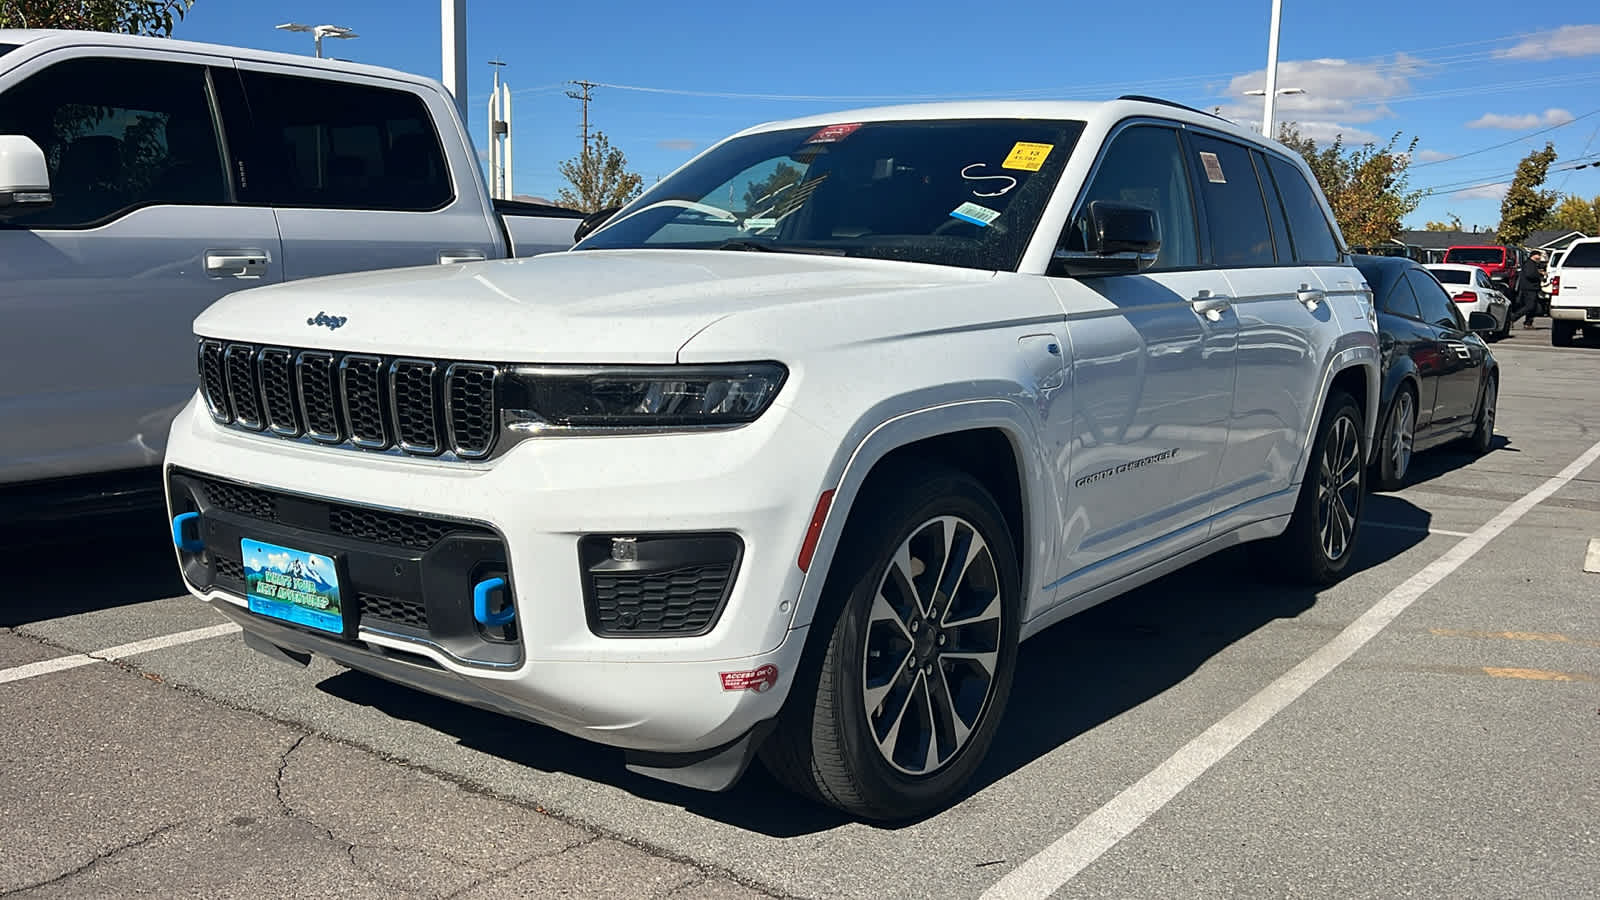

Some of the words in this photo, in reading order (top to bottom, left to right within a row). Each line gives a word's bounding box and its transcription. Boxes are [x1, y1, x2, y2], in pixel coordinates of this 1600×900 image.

[306, 311, 348, 331] Jeep
[1075, 468, 1114, 488] GRAND
[1115, 448, 1180, 474] CHEROKEE
[256, 581, 277, 597] NEXT
[277, 587, 330, 609] ADVENTURE?
[293, 578, 316, 594] YOUR
